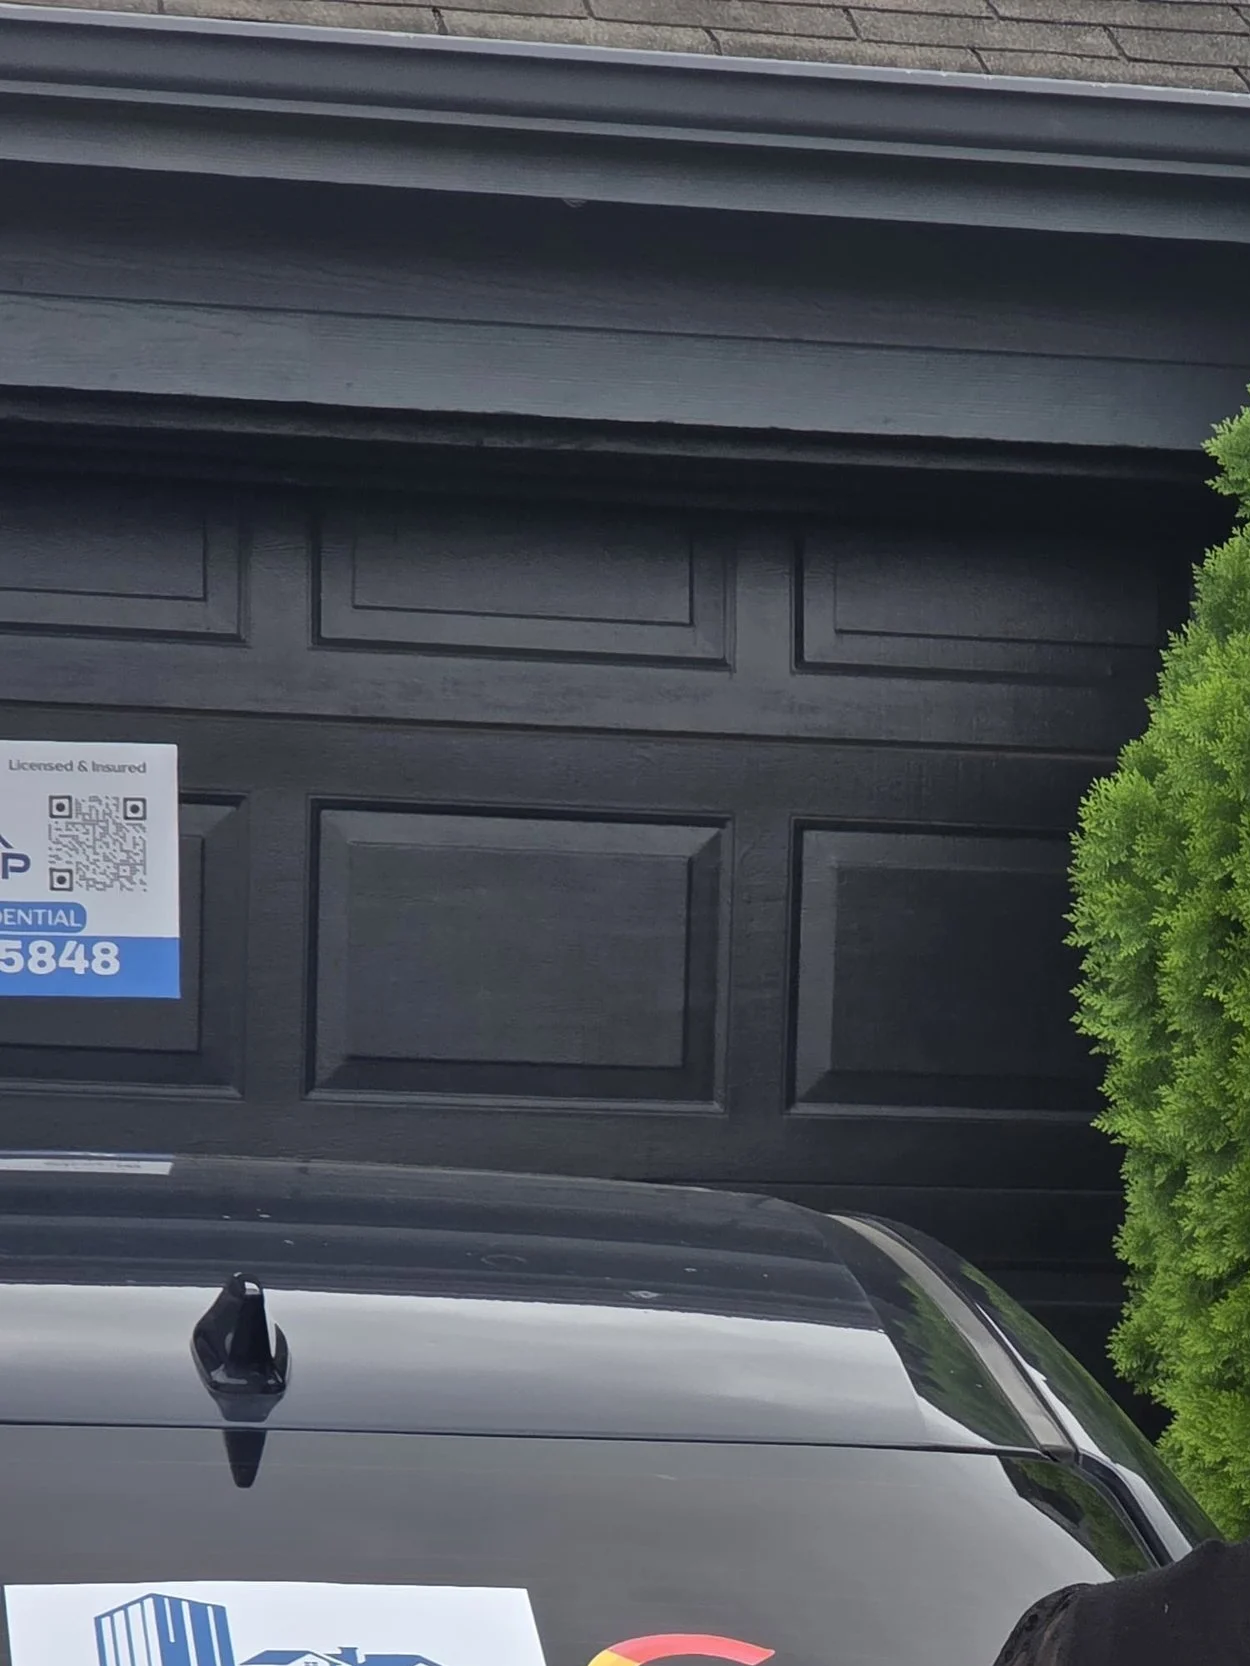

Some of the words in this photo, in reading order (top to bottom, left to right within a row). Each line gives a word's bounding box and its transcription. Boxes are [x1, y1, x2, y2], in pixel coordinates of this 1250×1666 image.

[8, 759, 74, 773] Licensed
[77, 760, 89, 773] &
[92, 761, 147, 774] Insured
[0, 908, 82, 928] ENTIAL
[0, 940, 120, 976] 5848
